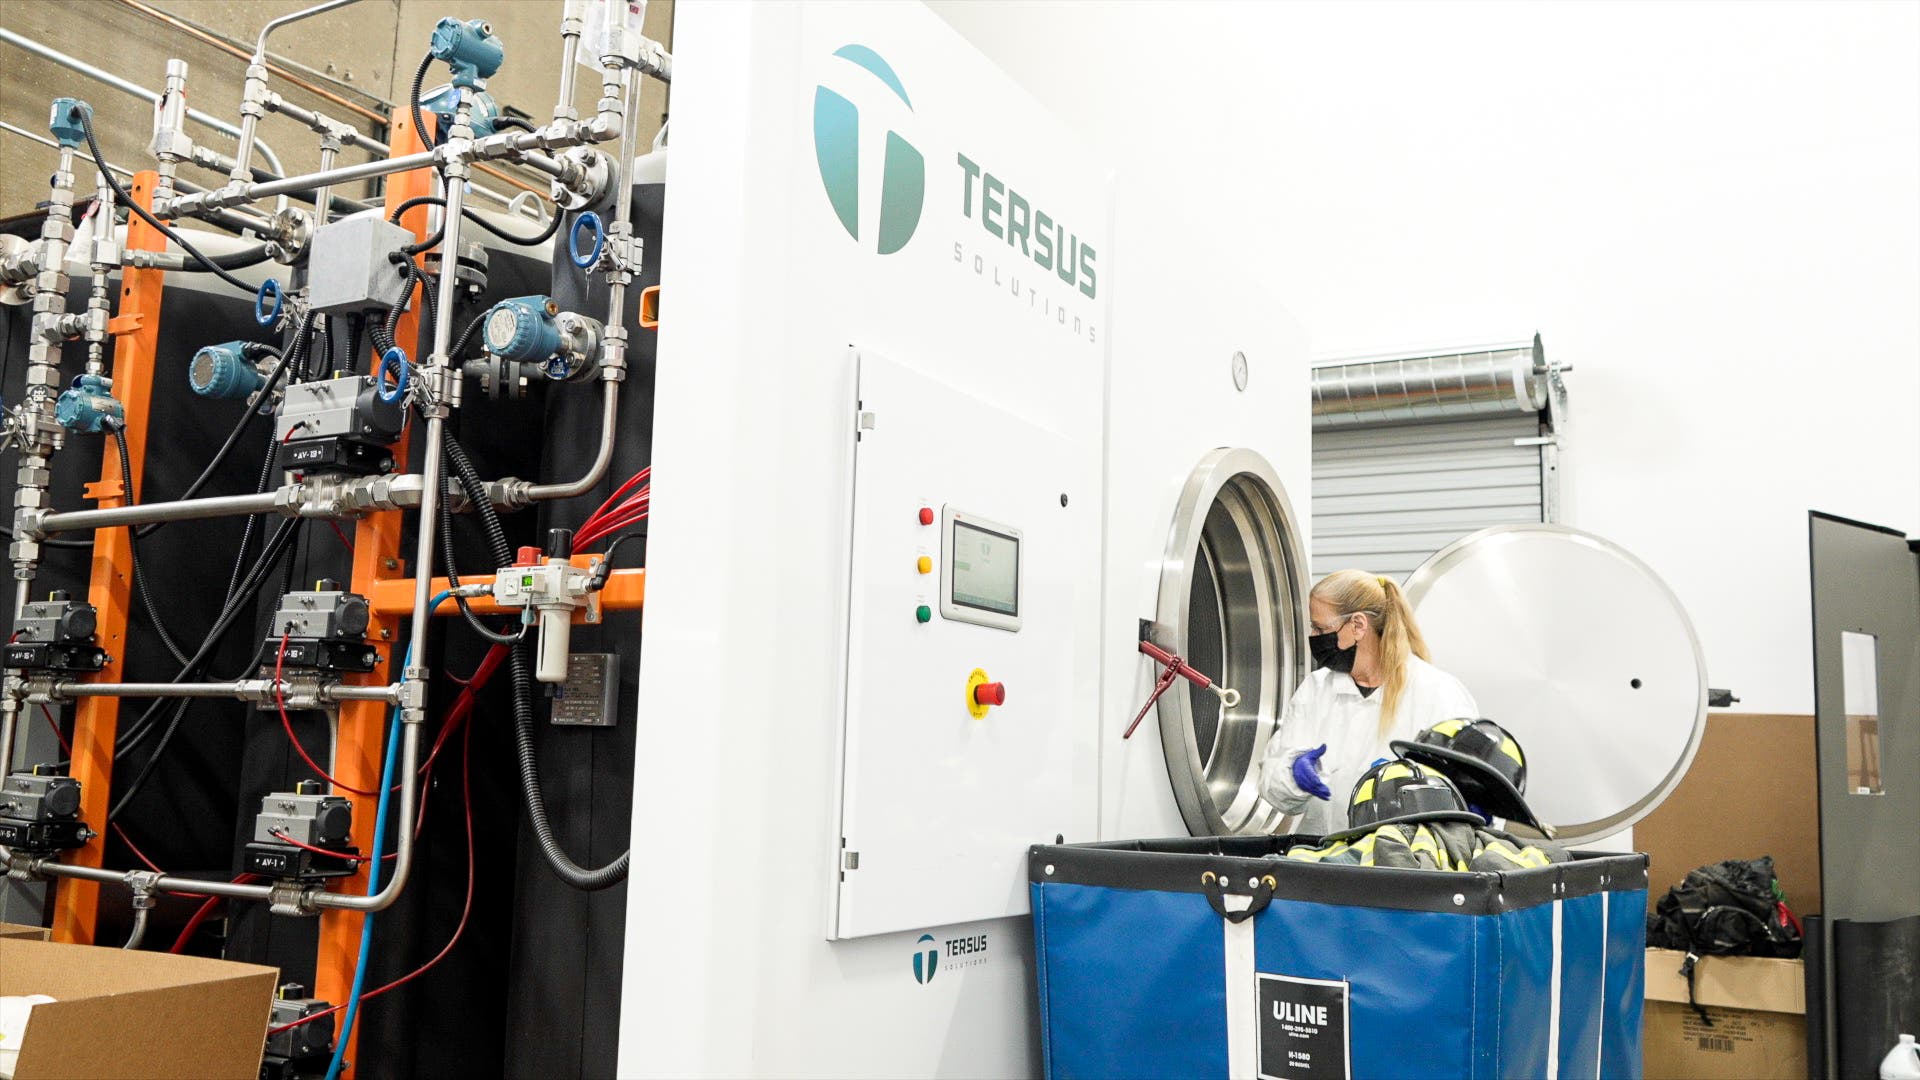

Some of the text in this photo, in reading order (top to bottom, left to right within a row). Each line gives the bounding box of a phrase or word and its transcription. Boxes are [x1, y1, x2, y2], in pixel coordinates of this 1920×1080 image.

[957, 151, 1096, 300] TERSUS
[945, 935, 987, 957] TERSUS
[1272, 1000, 1328, 1027] ULINE
